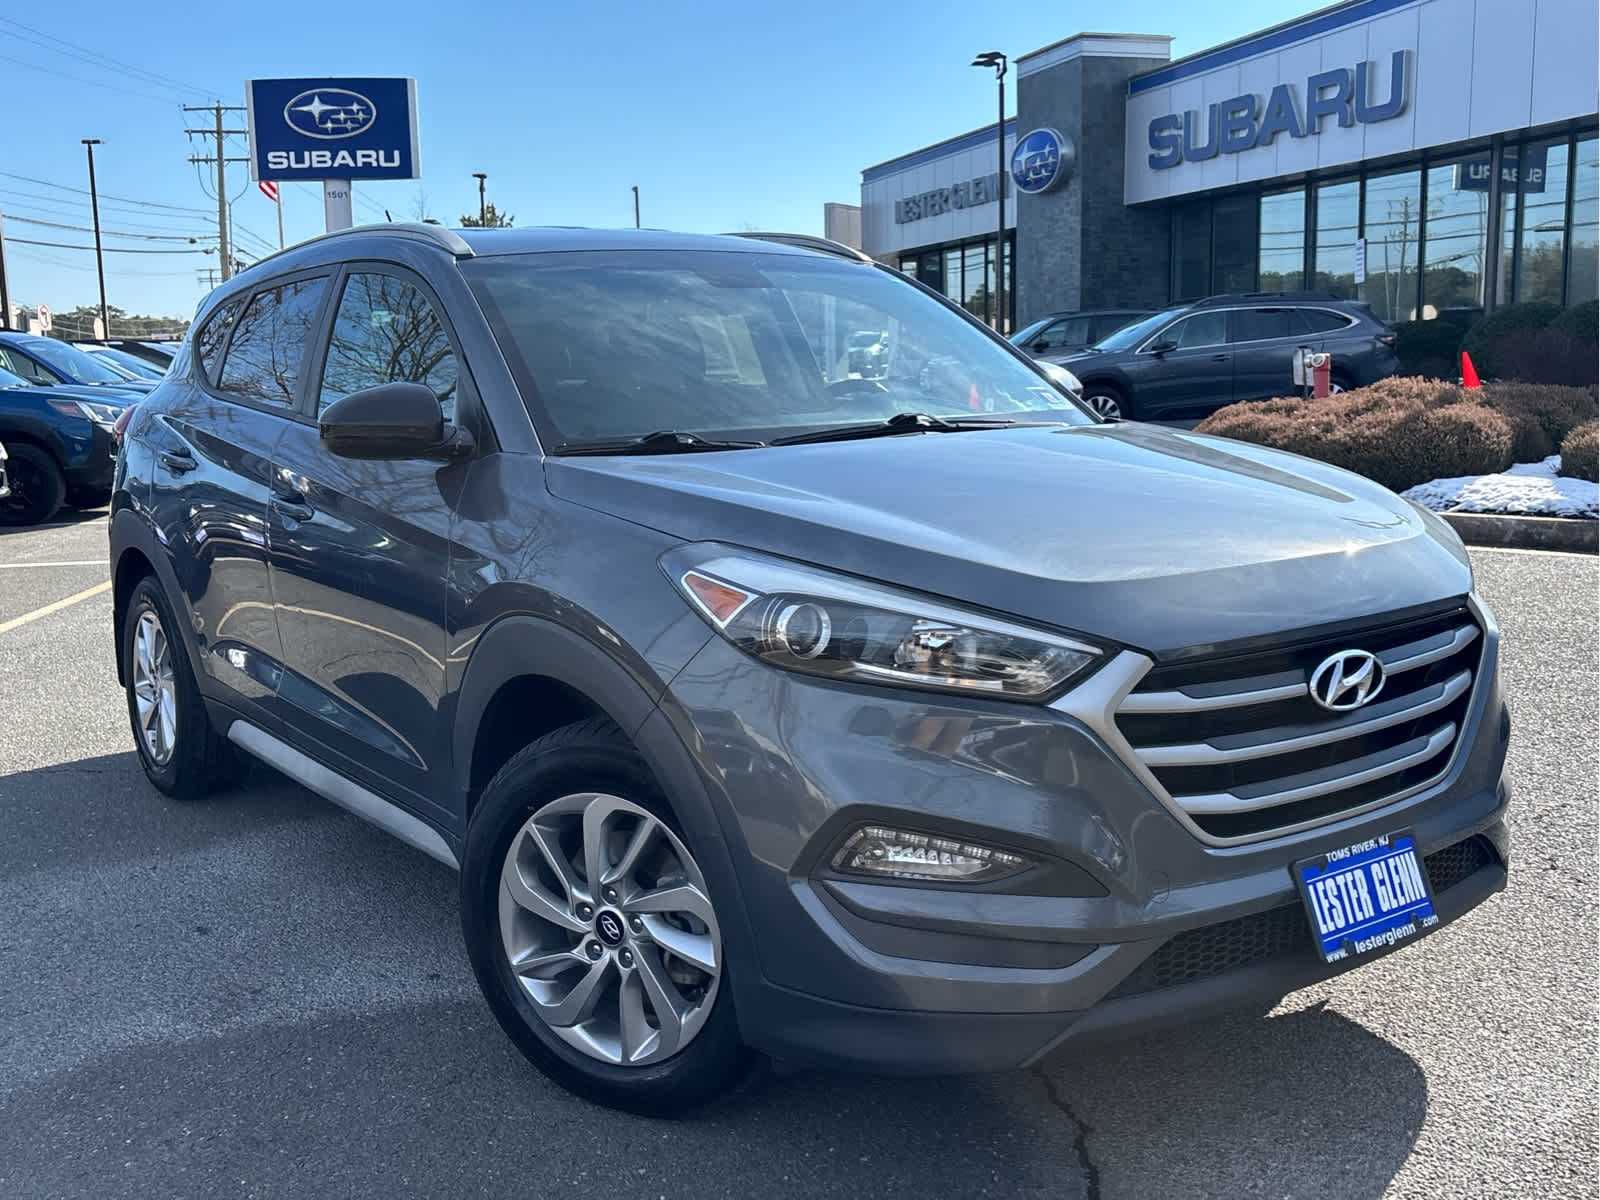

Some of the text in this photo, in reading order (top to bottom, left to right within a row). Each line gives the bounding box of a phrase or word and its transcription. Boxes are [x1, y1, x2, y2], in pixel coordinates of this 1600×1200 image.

[1148, 49, 1410, 171] SUBARU
[267, 149, 400, 169] SUBARU
[327, 191, 348, 199] 1501
[895, 171, 1010, 224] LESTER GLENN
[1326, 849, 1350, 863] TOMS
[1379, 834, 1390, 847] NJ
[1308, 851, 1427, 935] LESTER GLENN
[1326, 948, 1348, 963] www.
[1354, 922, 1416, 954] lesterglenn
